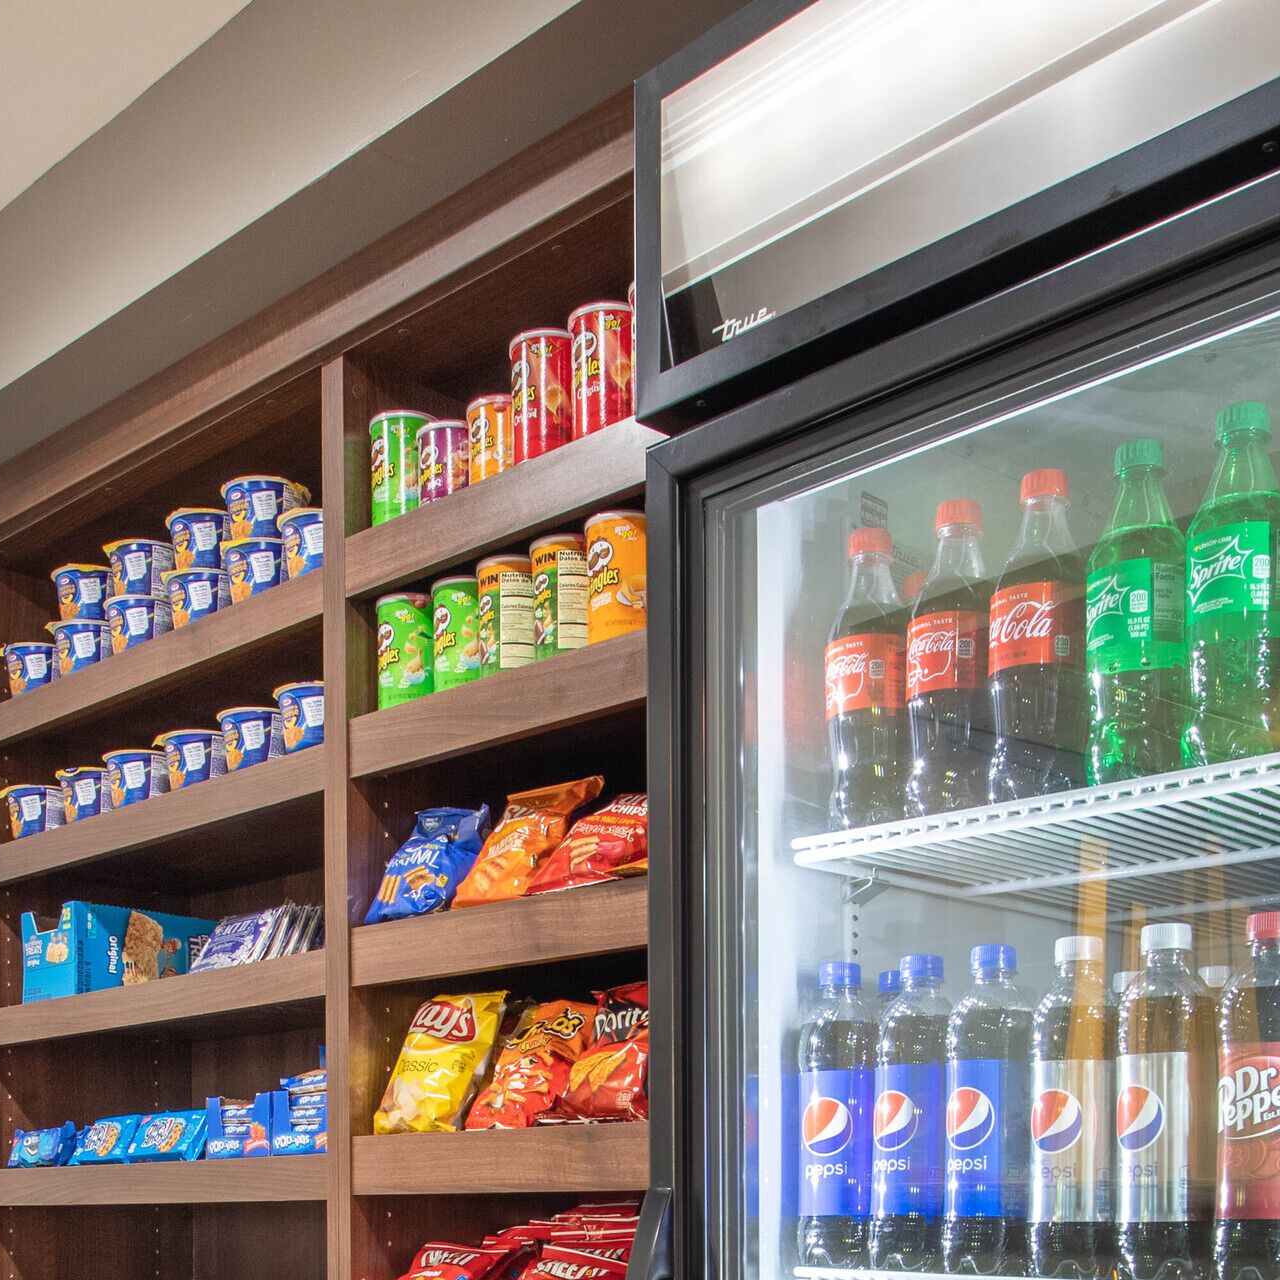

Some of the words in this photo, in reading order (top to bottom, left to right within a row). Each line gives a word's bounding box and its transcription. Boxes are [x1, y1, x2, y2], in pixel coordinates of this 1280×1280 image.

[535, 552, 556, 566] WIN
[1190, 553, 1242, 591] Sprite
[480, 574, 498, 588] WIN
[1009, 592, 1029, 601] TASTE
[1131, 592, 1147, 603] 200
[933, 617, 953, 626] TASTE
[959, 639, 973, 649] 200
[1055, 636, 1069, 647] 200
[870, 660, 884, 670] 200
[108, 935, 119, 974] Original
[1234, 1065, 1279, 1100] Dr
[805, 1160, 848, 1179] pepsi
[873, 1155, 911, 1175] pepsi
[947, 1155, 987, 1174] pepsi
[1041, 1162, 1078, 1182] epsi
